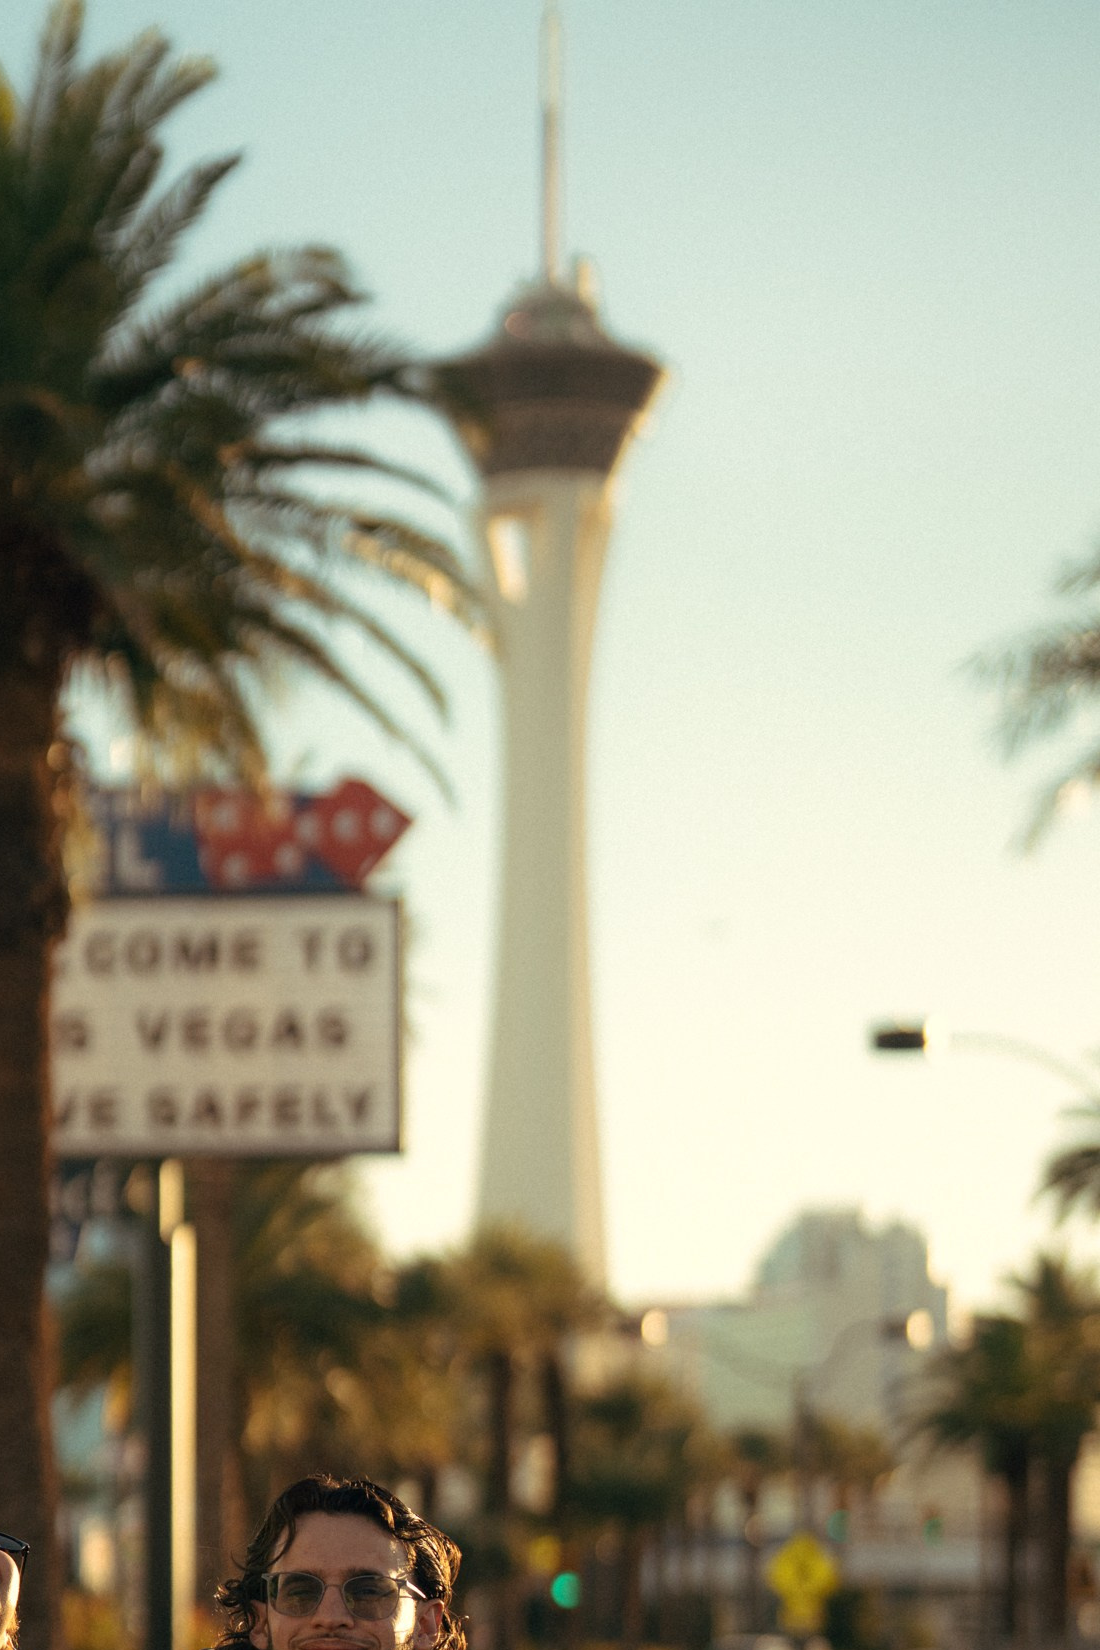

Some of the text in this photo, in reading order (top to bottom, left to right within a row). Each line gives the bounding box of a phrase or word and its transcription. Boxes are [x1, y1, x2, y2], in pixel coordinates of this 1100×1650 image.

[51, 924, 372, 978] COME TO
[134, 1004, 349, 1054] VEGAS
[149, 1083, 372, 1131] SAFELY
